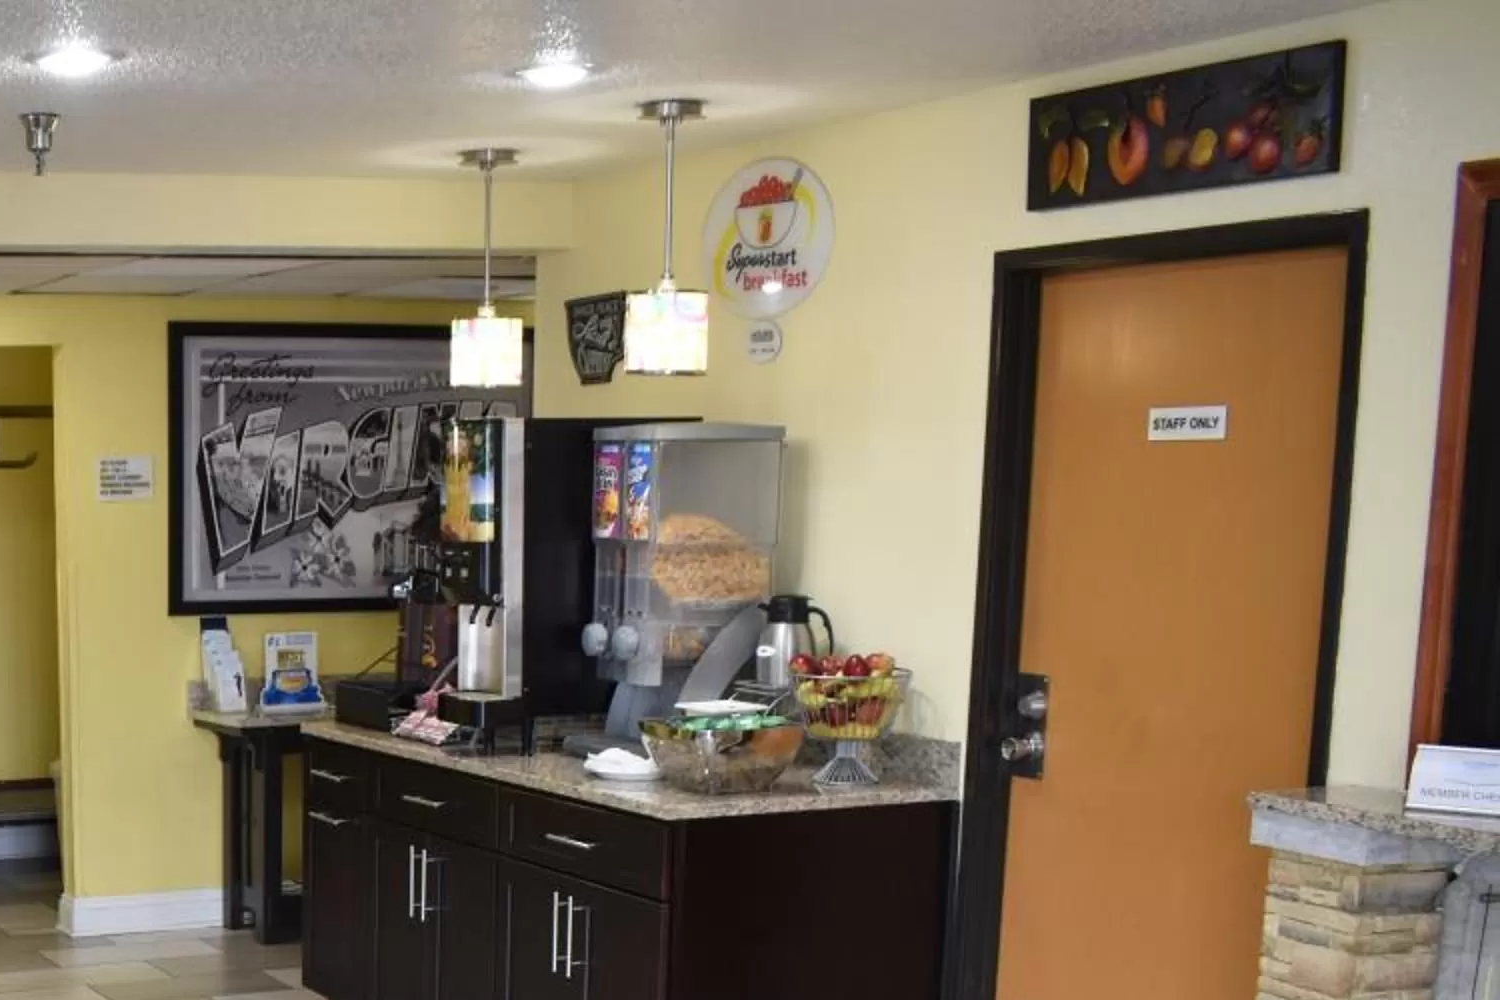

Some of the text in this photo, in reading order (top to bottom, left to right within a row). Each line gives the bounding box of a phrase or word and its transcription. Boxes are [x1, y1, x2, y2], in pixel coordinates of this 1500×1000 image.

[726, 242, 797, 284] Superstart
[201, 352, 315, 399] Greetings
[225, 382, 299, 417] from
[1152, 416, 1220, 431] STAFF ONLY
[196, 401, 517, 575] VIRGIN
